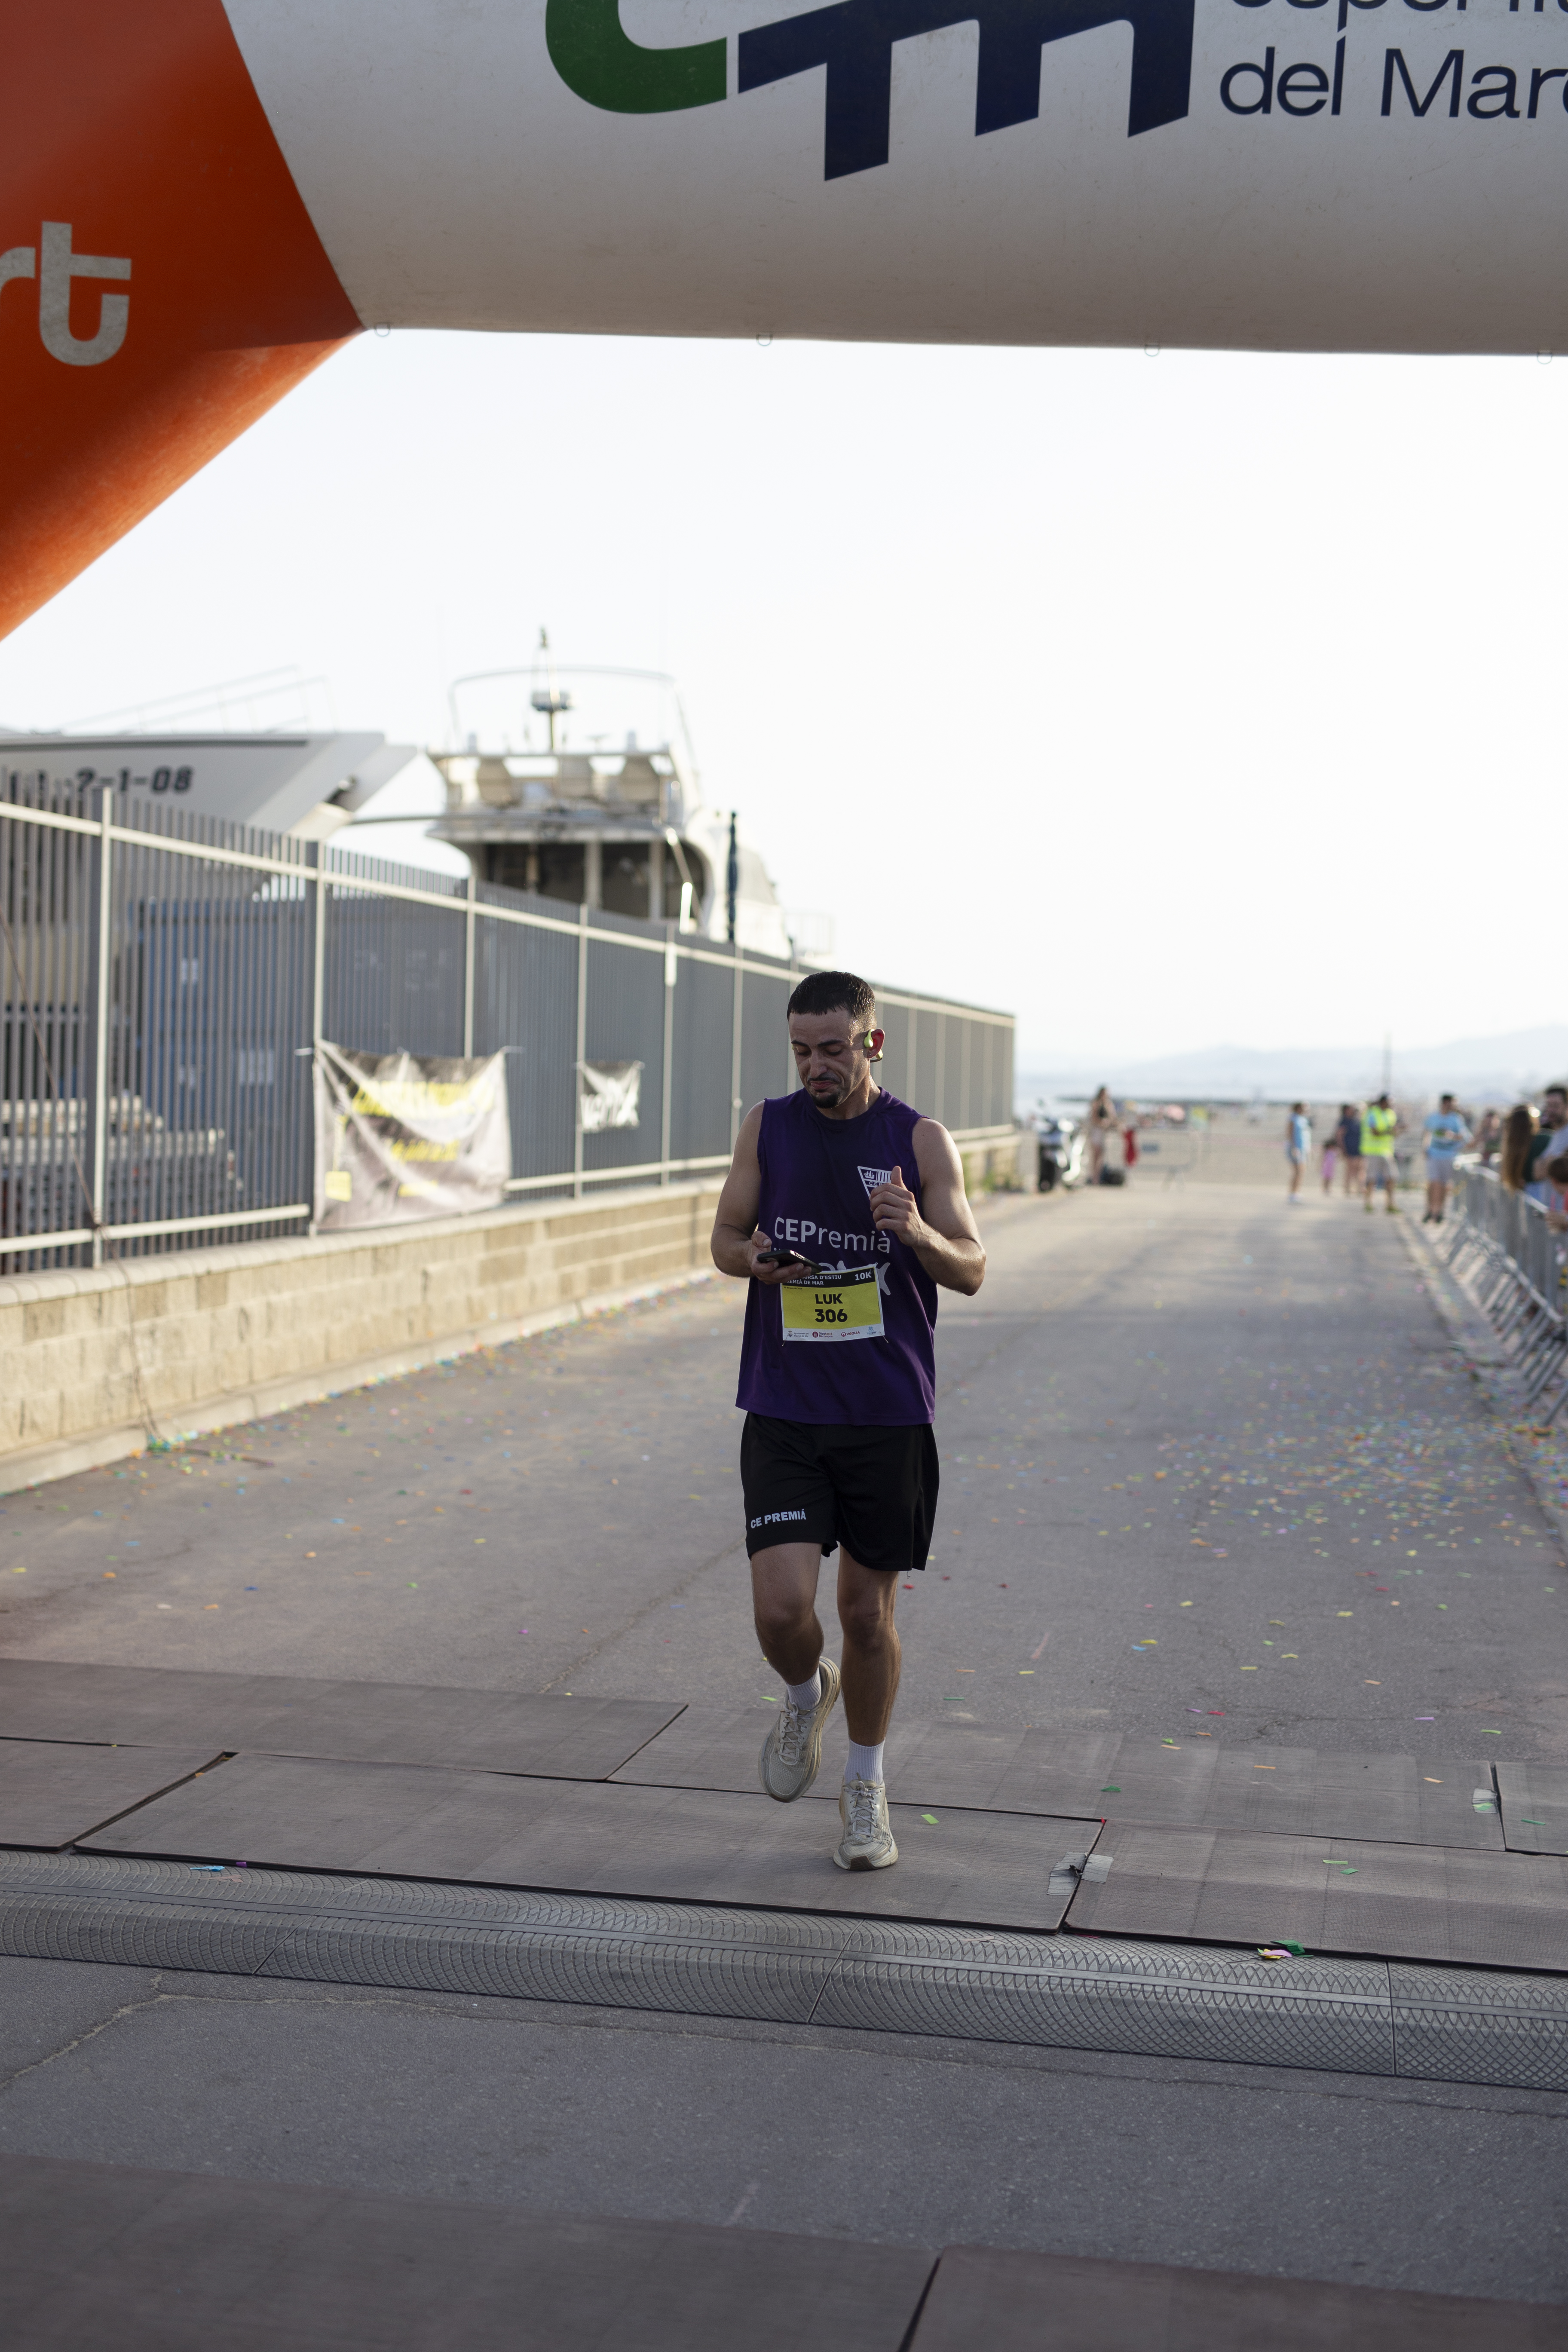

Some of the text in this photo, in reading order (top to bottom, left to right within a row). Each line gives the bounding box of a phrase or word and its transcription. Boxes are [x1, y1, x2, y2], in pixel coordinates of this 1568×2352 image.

[1220, 35, 1568, 119] del Mar
[775, 1217, 890, 1253] CEPremià
[855, 1271, 872, 1280] 10K
[815, 1293, 843, 1305] LUK
[815, 1308, 848, 1323] 306
[750, 1517, 762, 1528] CE
